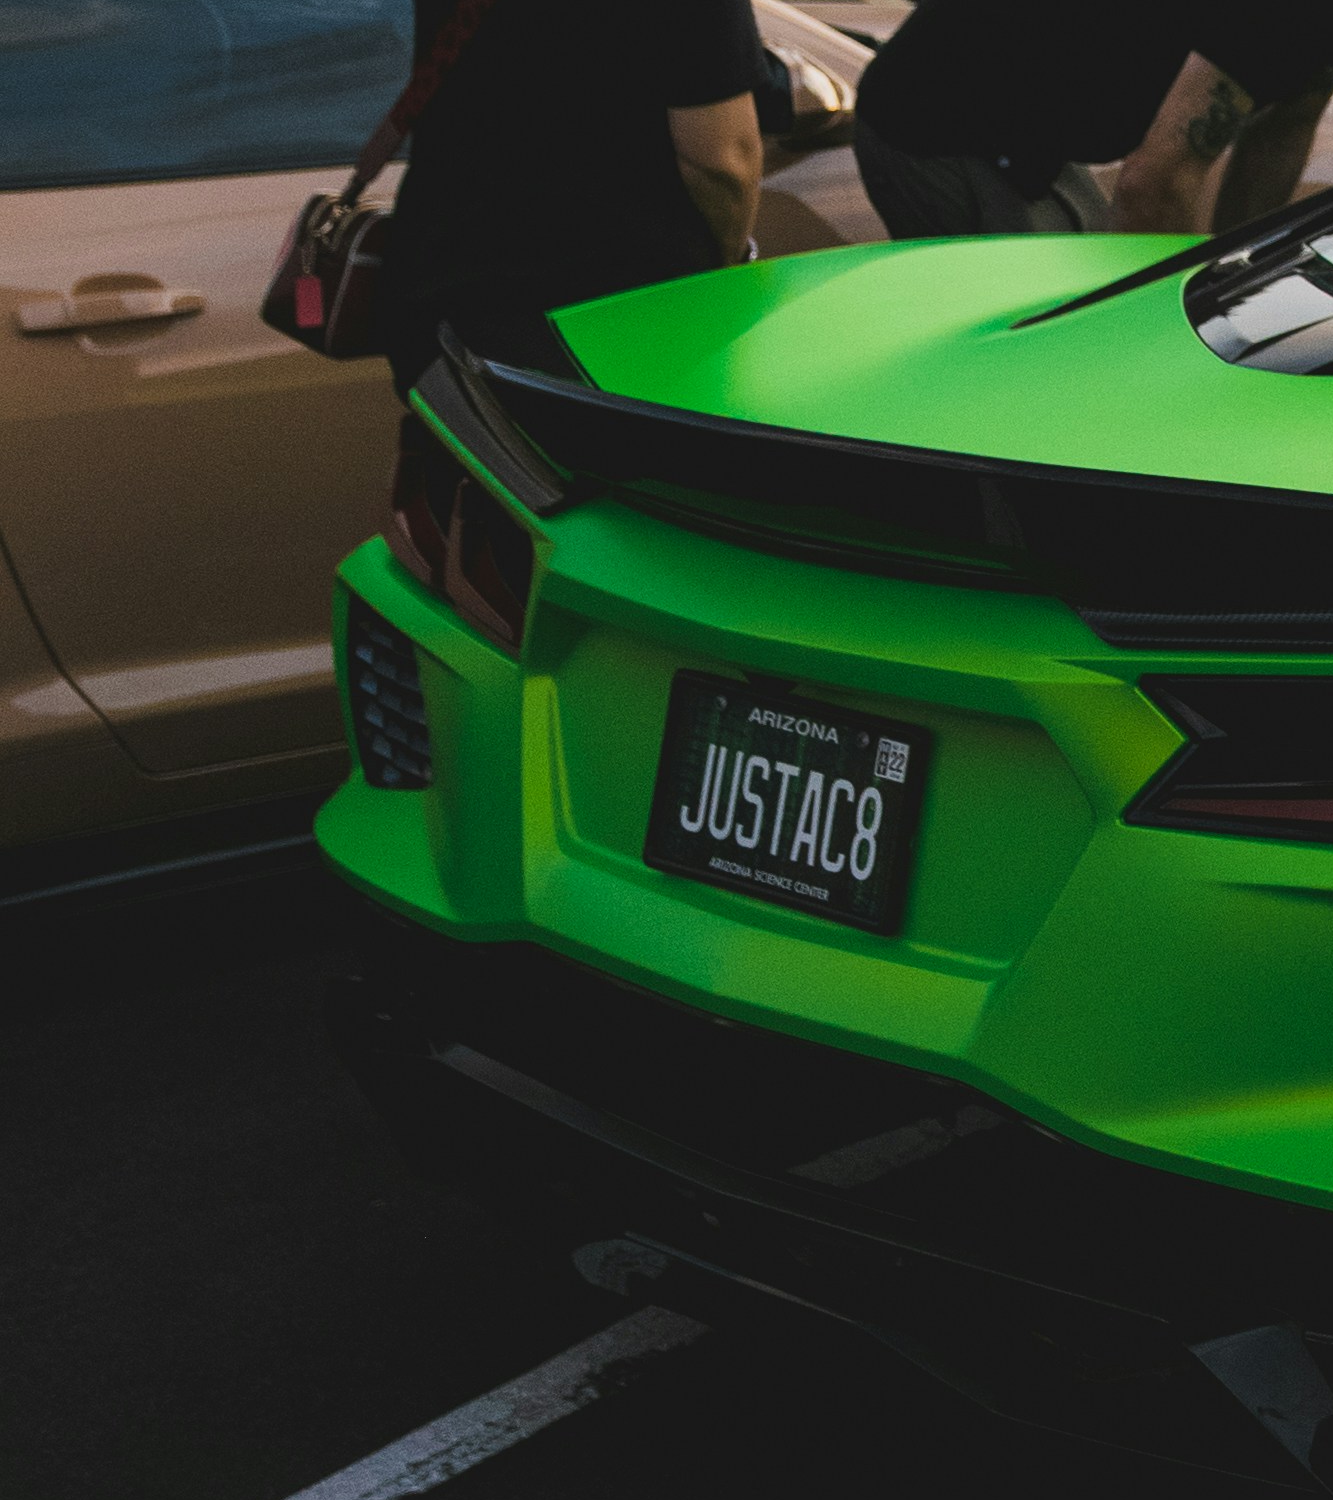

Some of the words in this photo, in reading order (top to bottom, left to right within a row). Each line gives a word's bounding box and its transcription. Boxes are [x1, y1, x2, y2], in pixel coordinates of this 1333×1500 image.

[748, 707, 839, 744] ARIZONA
[889, 750, 906, 773] 22
[679, 743, 884, 881] JUSTAC8
[708, 856, 752, 878] ARIZONA
[753, 869, 793, 891] SCIENCE
[793, 880, 830, 902] CENTER
